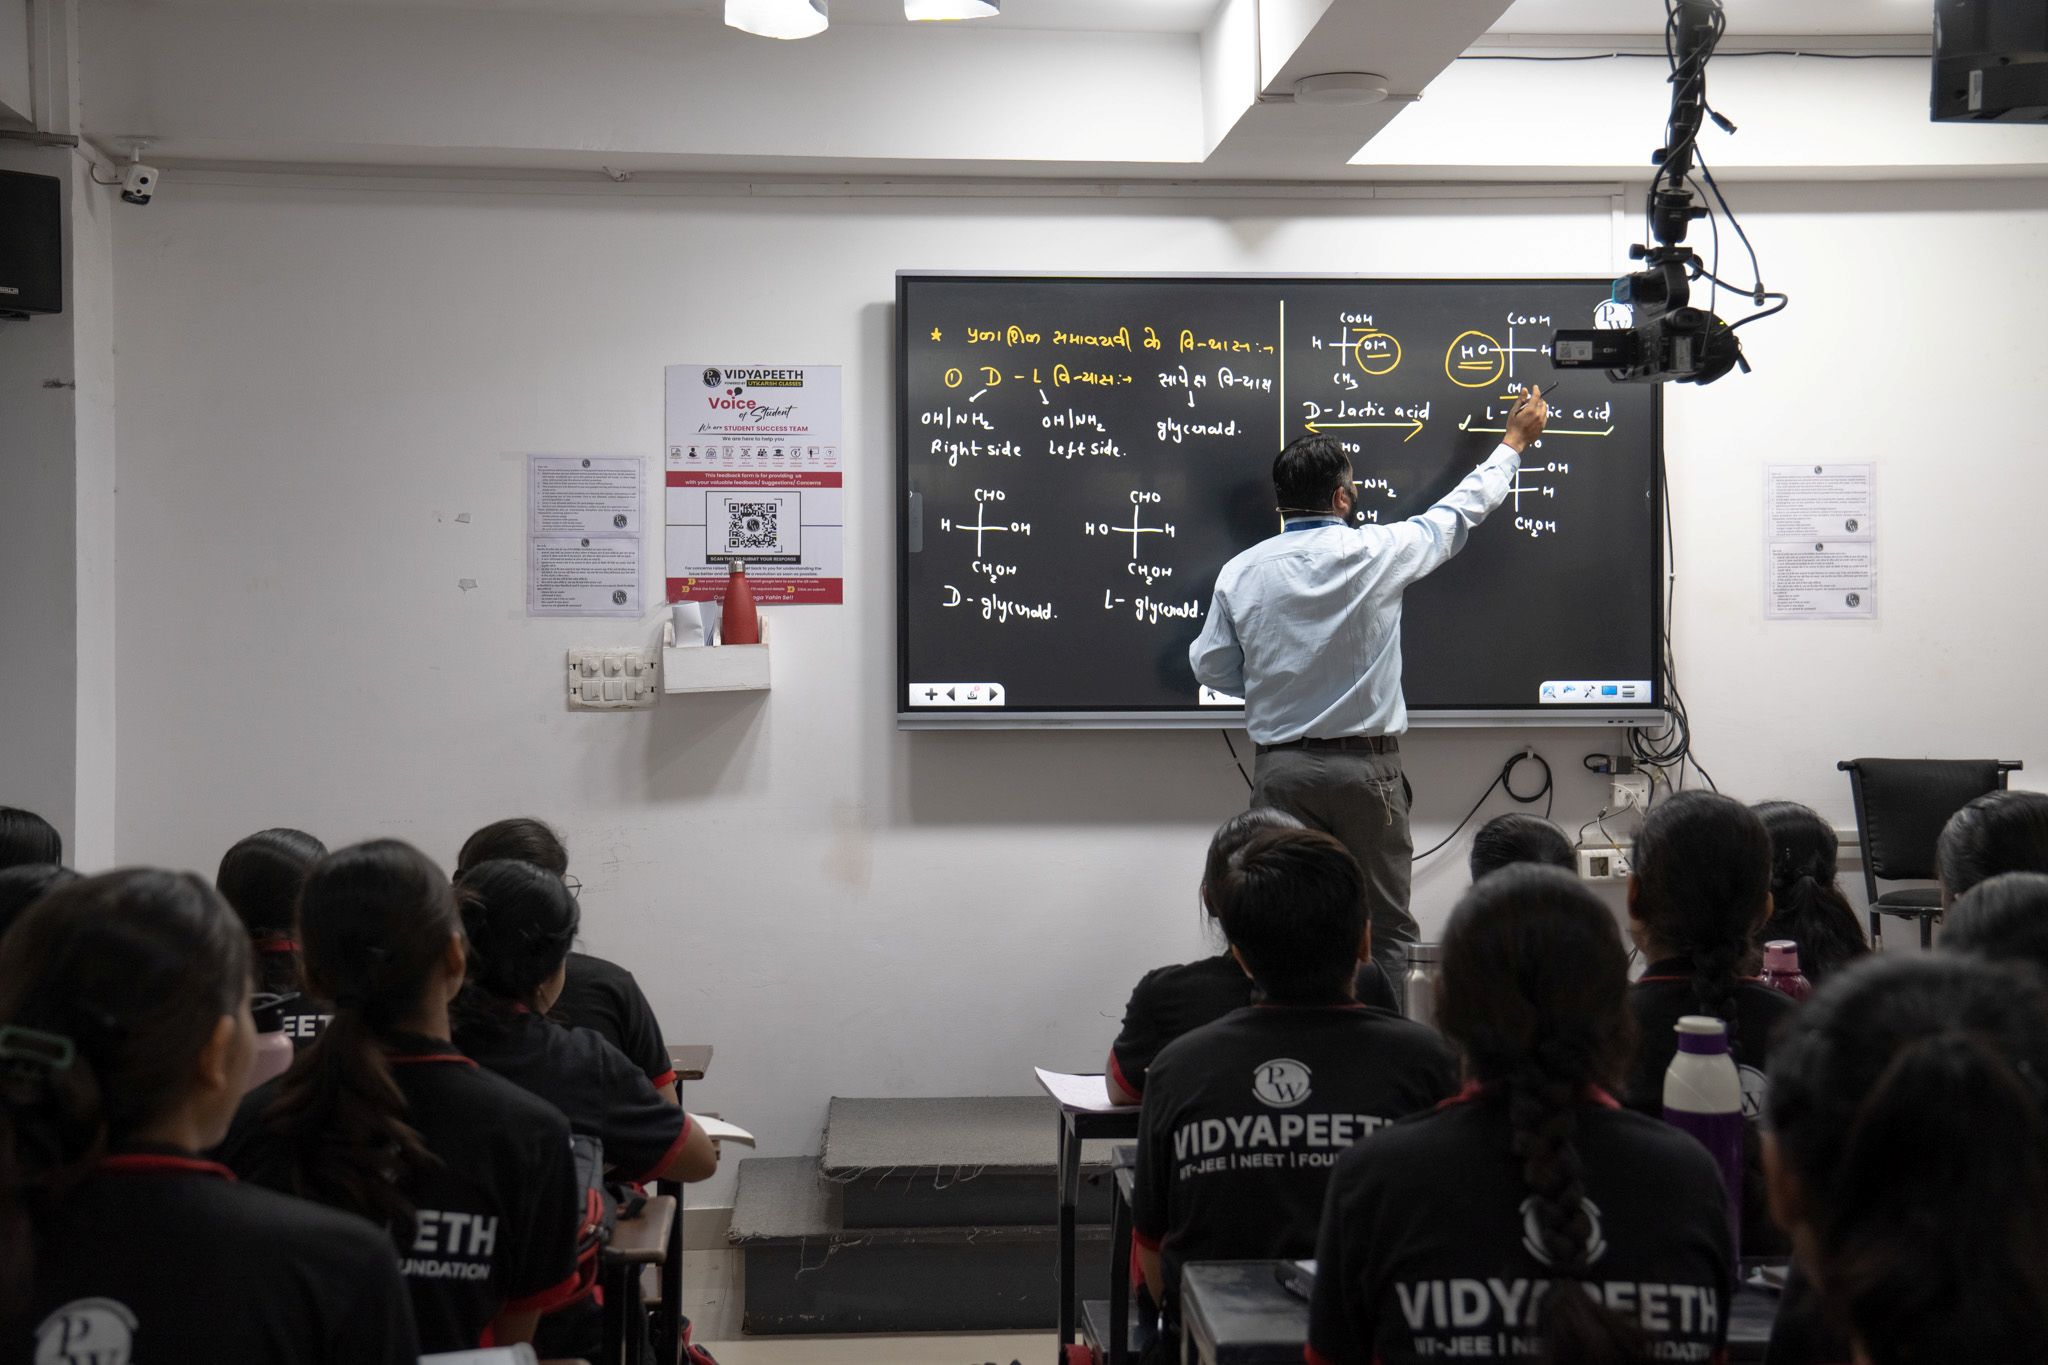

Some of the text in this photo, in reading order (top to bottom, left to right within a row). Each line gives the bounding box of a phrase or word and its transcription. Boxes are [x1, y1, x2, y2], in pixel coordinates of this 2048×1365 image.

[1507, 312, 1550, 326] COOH
[1143, 327, 1161, 350] के
[1312, 336, 1322, 350] H
[1461, 344, 1488, 359] HO
[724, 369, 803, 380] VIDYAPEETH
[708, 396, 756, 410] Voice
[738, 405, 798, 422] of Student
[1395, 401, 1430, 421] acid
[1573, 401, 1611, 422] acid
[698, 422, 711, 433] We
[931, 439, 1022, 467] Right side
[1547, 462, 1568, 474] OH
[974, 488, 1006, 501] CHO
[1130, 490, 1161, 504] CHO
[1542, 486, 1555, 498] H
[941, 518, 951, 532] H
[1011, 522, 1030, 535] OH
[1165, 523, 1175, 538] H
[1173, 1114, 1394, 1161] VIDYAPEET
[1240, 1153, 1285, 1168] NEET
[400, 1257, 491, 1280] UNDATION
